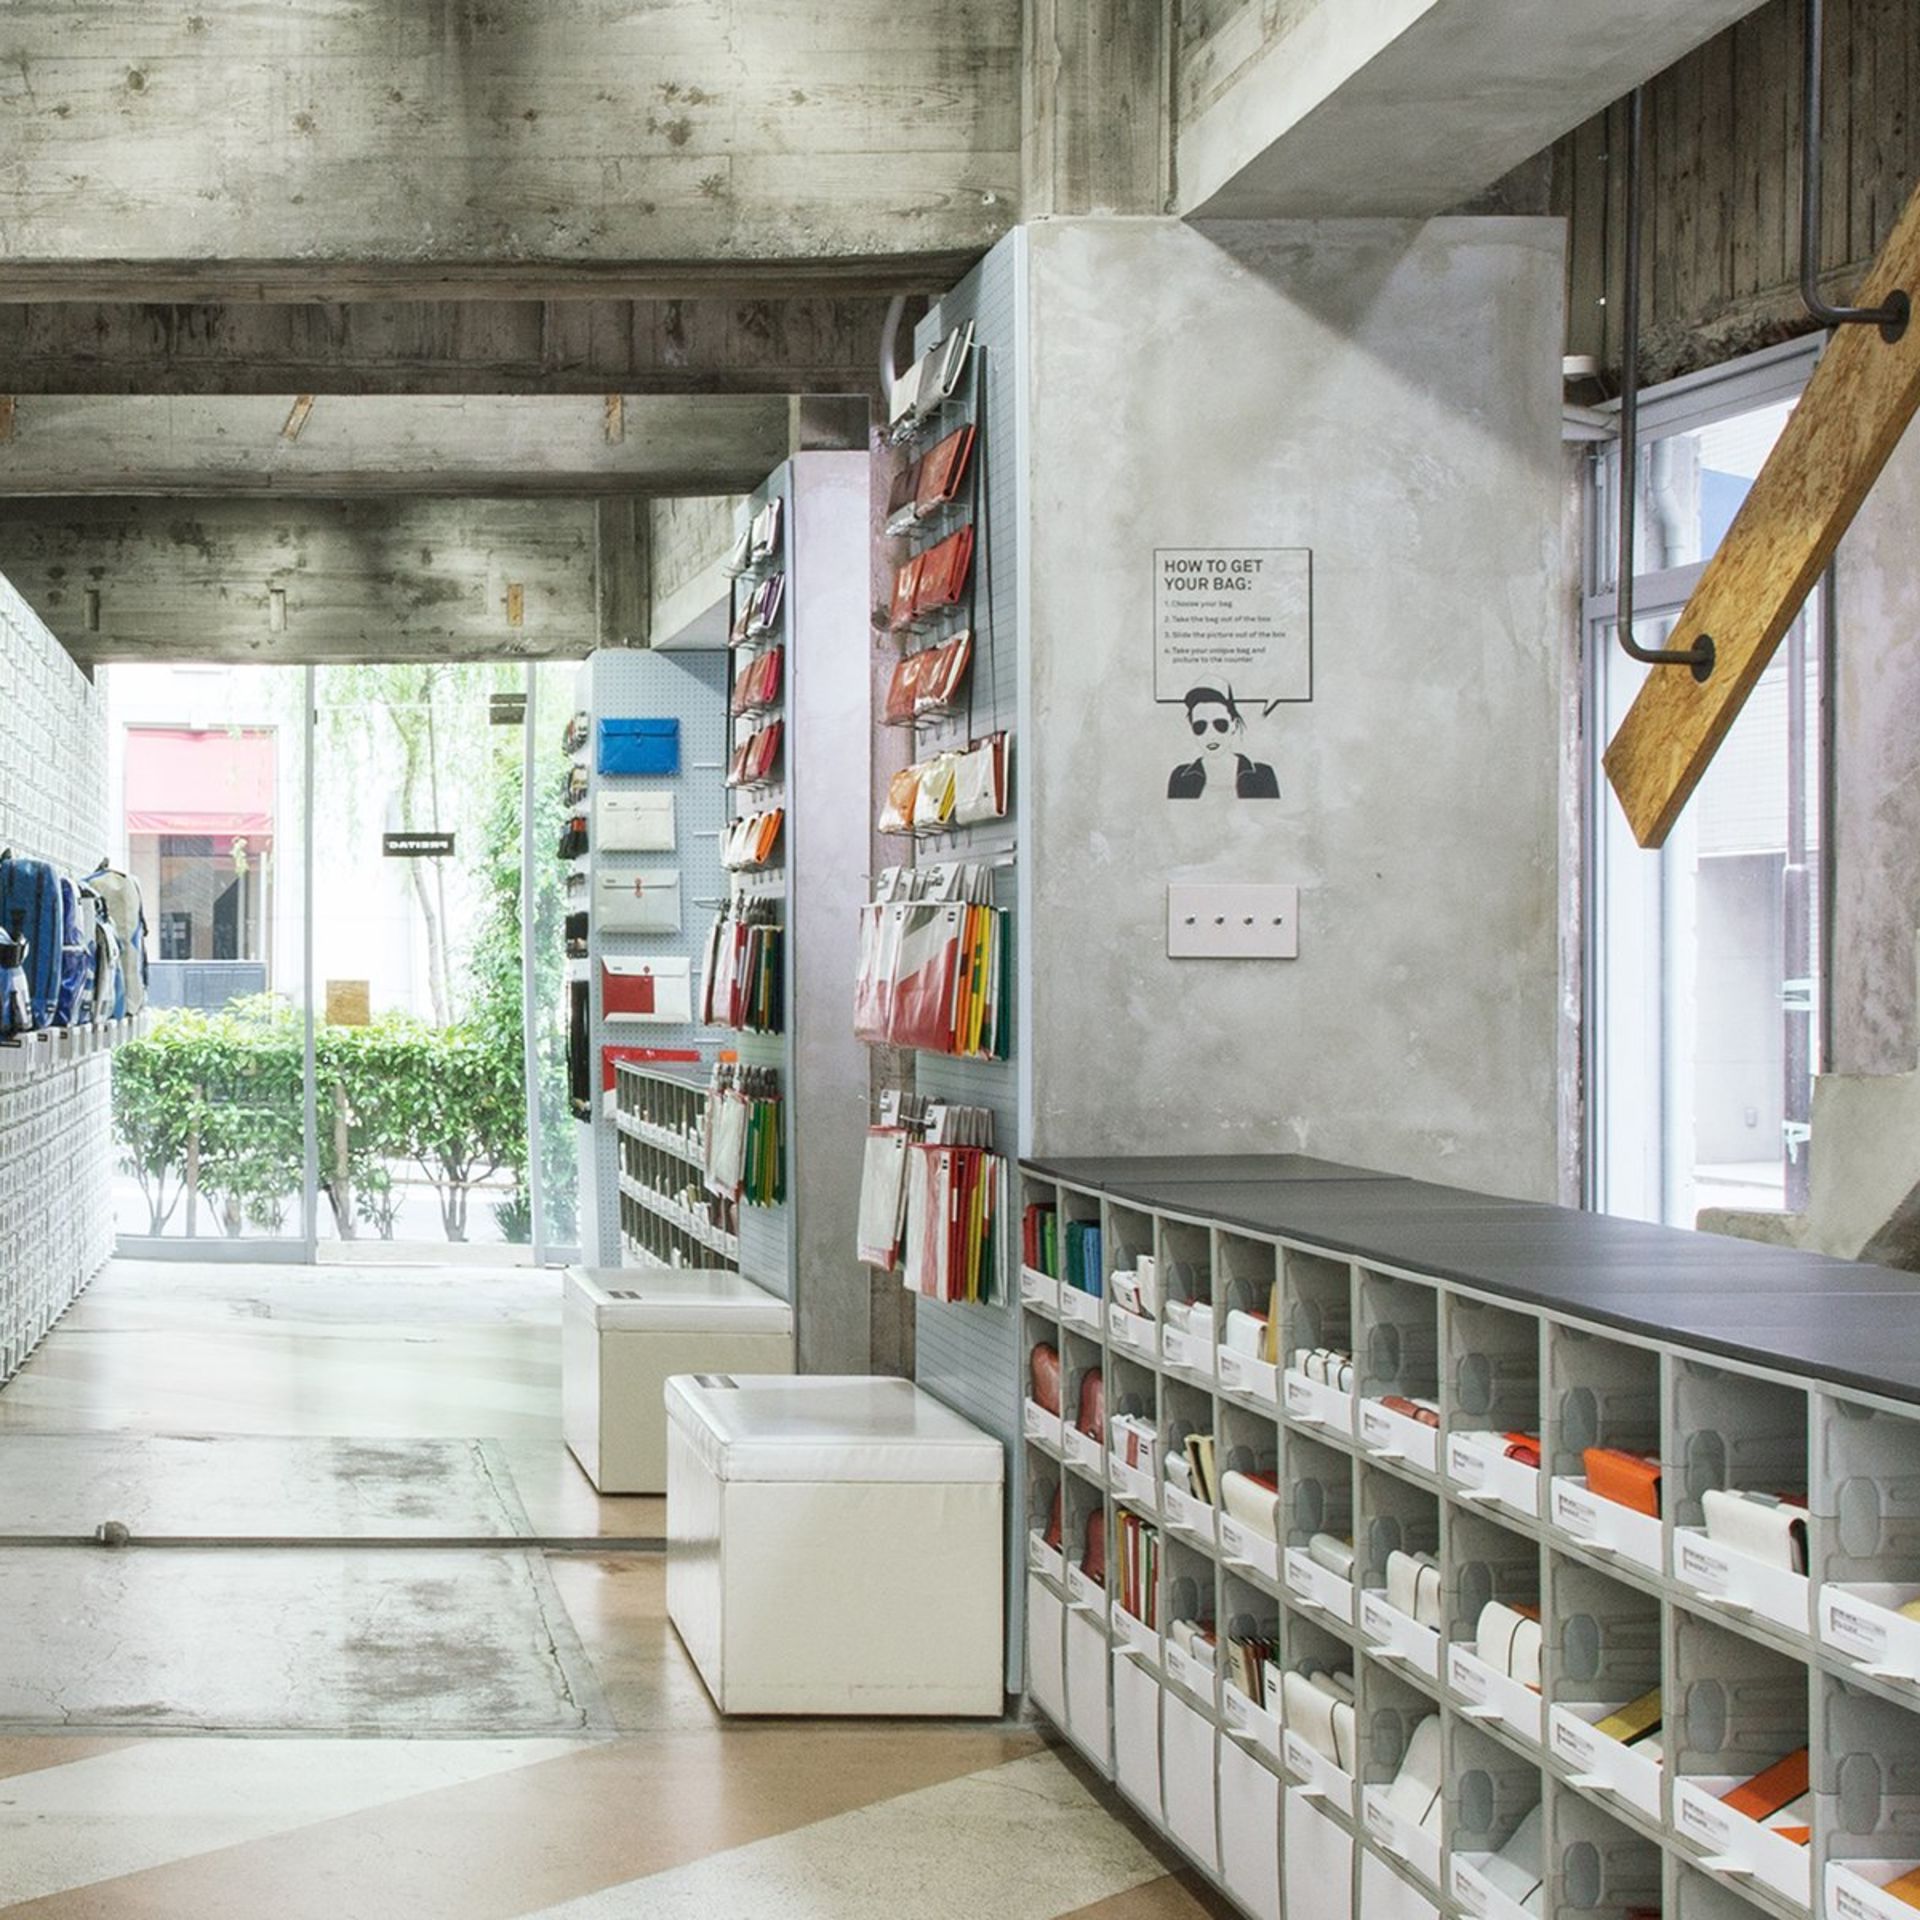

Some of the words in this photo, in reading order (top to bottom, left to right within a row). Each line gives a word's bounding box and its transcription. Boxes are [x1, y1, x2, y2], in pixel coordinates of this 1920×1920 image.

[1164, 559, 1202, 573] HOW
[1207, 559, 1227, 573] TO
[1231, 559, 1263, 573] GET
[1164, 577, 1209, 591] YOUR
[1213, 577, 1252, 591] BAG:
[1219, 601, 1233, 609] bag
[1205, 616, 1219, 624] bag
[1207, 632, 1234, 640] picture
[1210, 647, 1235, 655] unique
[1236, 647, 1250, 655] bag
[1172, 656, 1199, 664] picture
